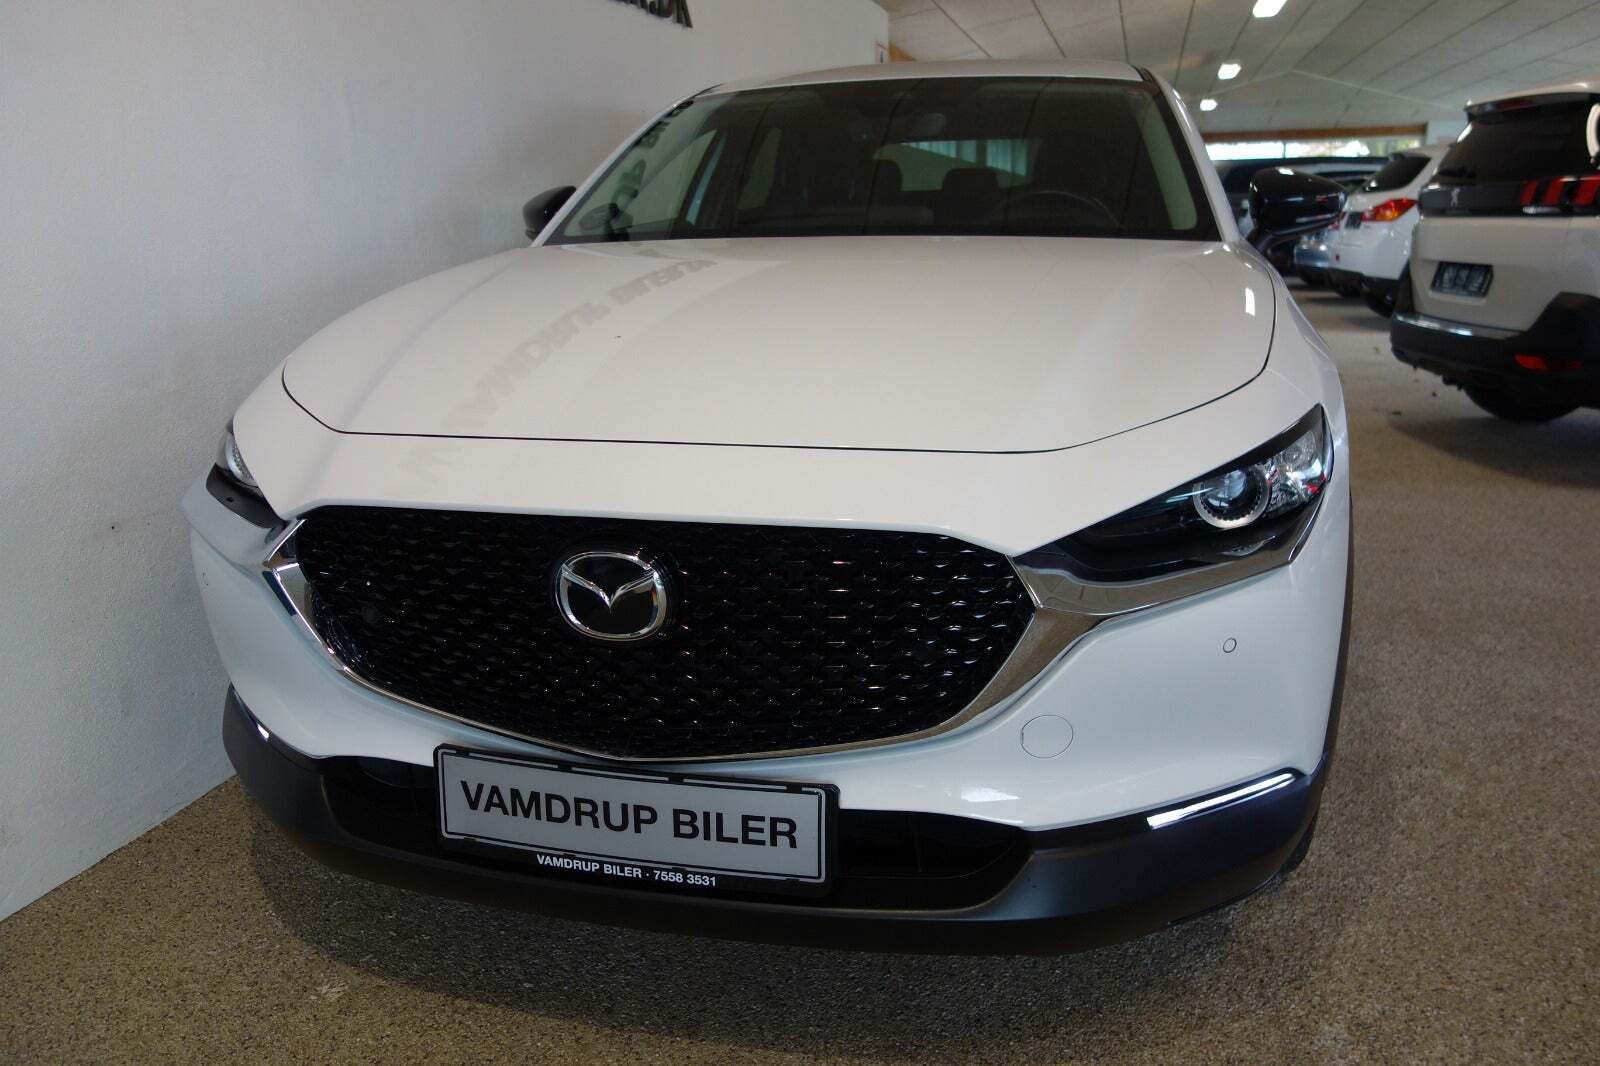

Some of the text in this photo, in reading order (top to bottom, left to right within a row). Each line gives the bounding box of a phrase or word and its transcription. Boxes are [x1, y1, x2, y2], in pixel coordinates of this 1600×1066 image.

[460, 780, 799, 849] VAMDRUP BILER
[536, 853, 717, 888] VAMDRUP BILER 7558 3531
